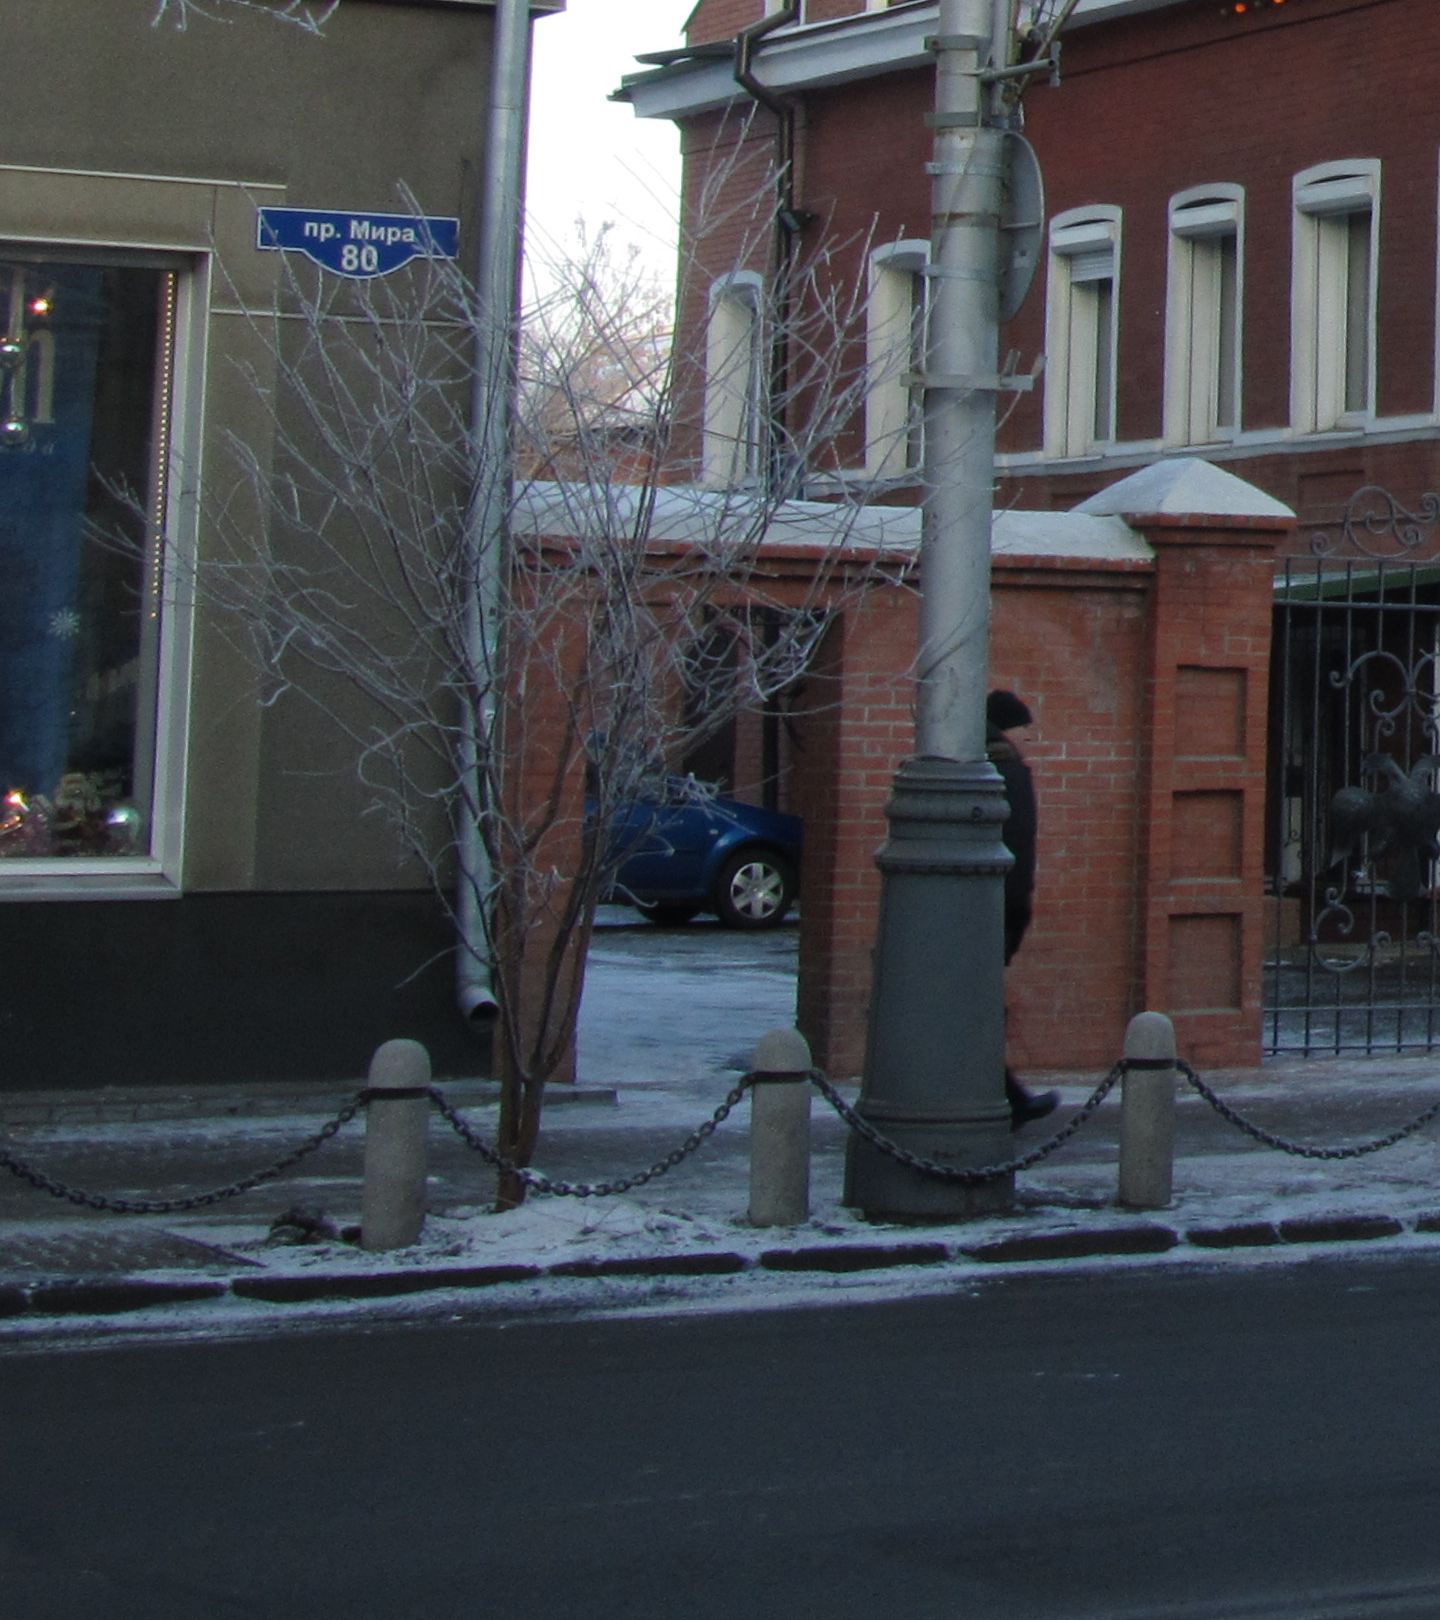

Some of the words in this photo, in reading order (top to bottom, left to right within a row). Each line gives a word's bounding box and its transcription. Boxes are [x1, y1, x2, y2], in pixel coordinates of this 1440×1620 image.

[303, 221, 341, 242] пр.
[350, 219, 415, 245] Мира
[341, 244, 379, 272] 80
